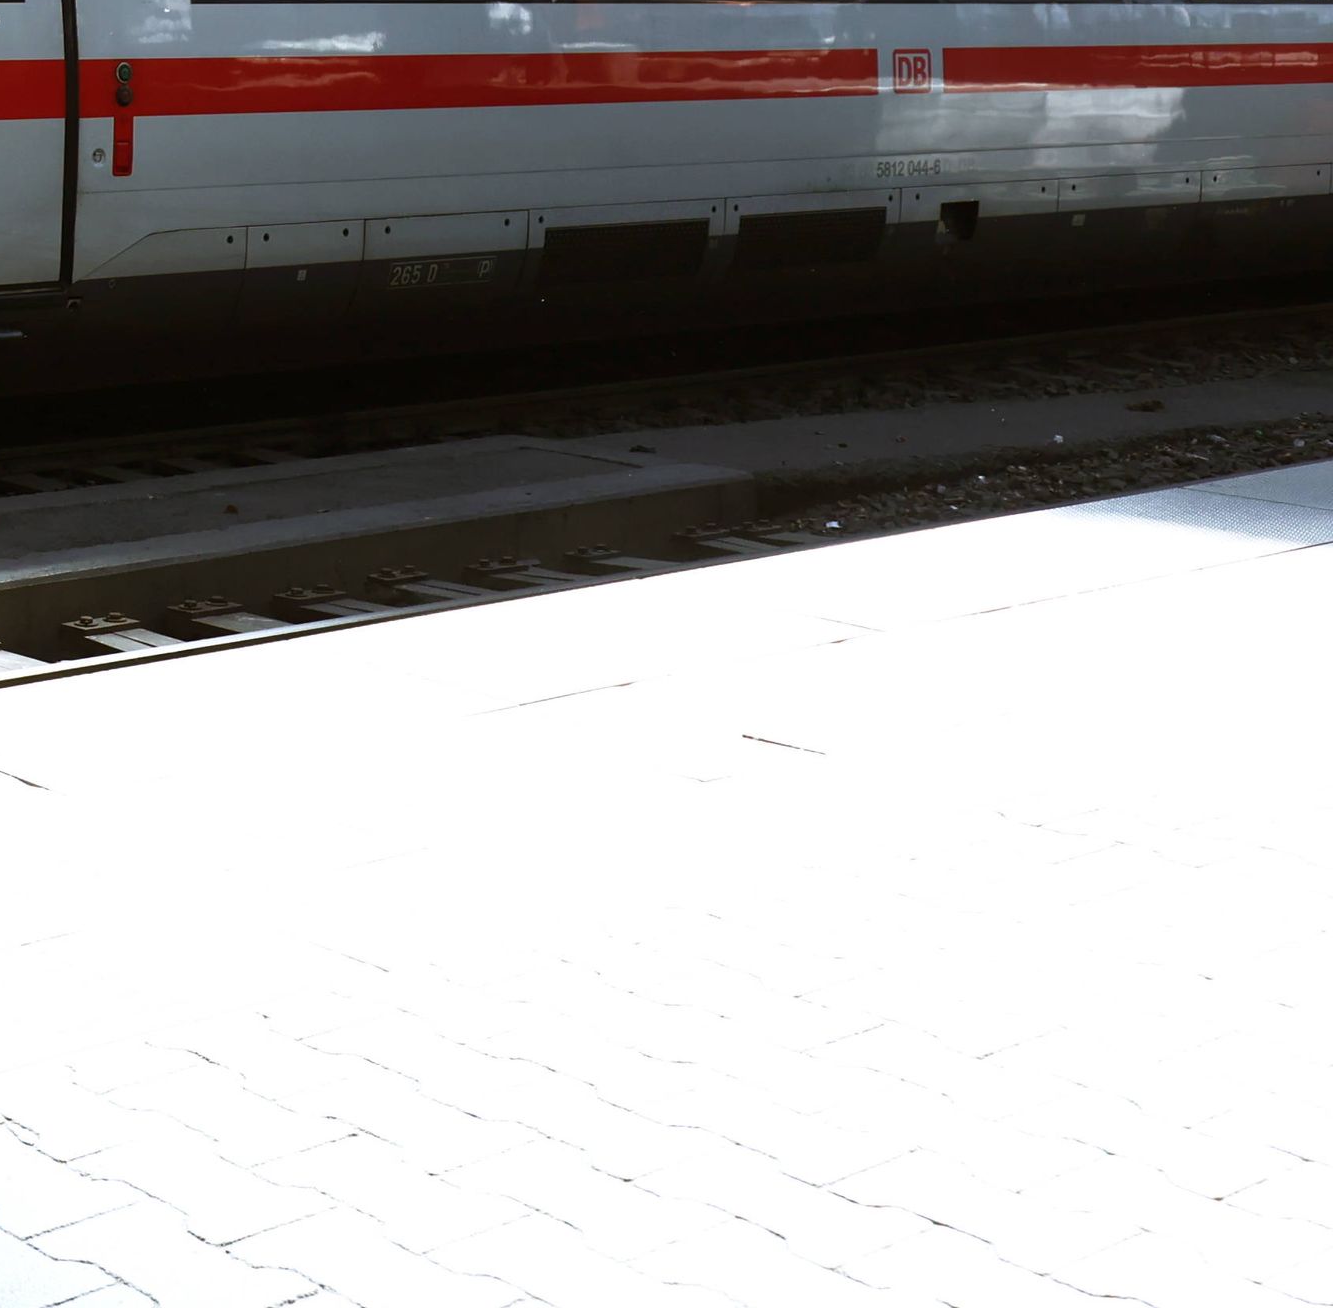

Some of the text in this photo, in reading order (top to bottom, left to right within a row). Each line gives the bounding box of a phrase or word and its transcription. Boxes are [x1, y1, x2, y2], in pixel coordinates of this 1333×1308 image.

[897, 55, 928, 87] DB
[876, 160, 906, 178] 5812
[907, 159, 941, 176] 044-6
[390, 264, 423, 286] 265
